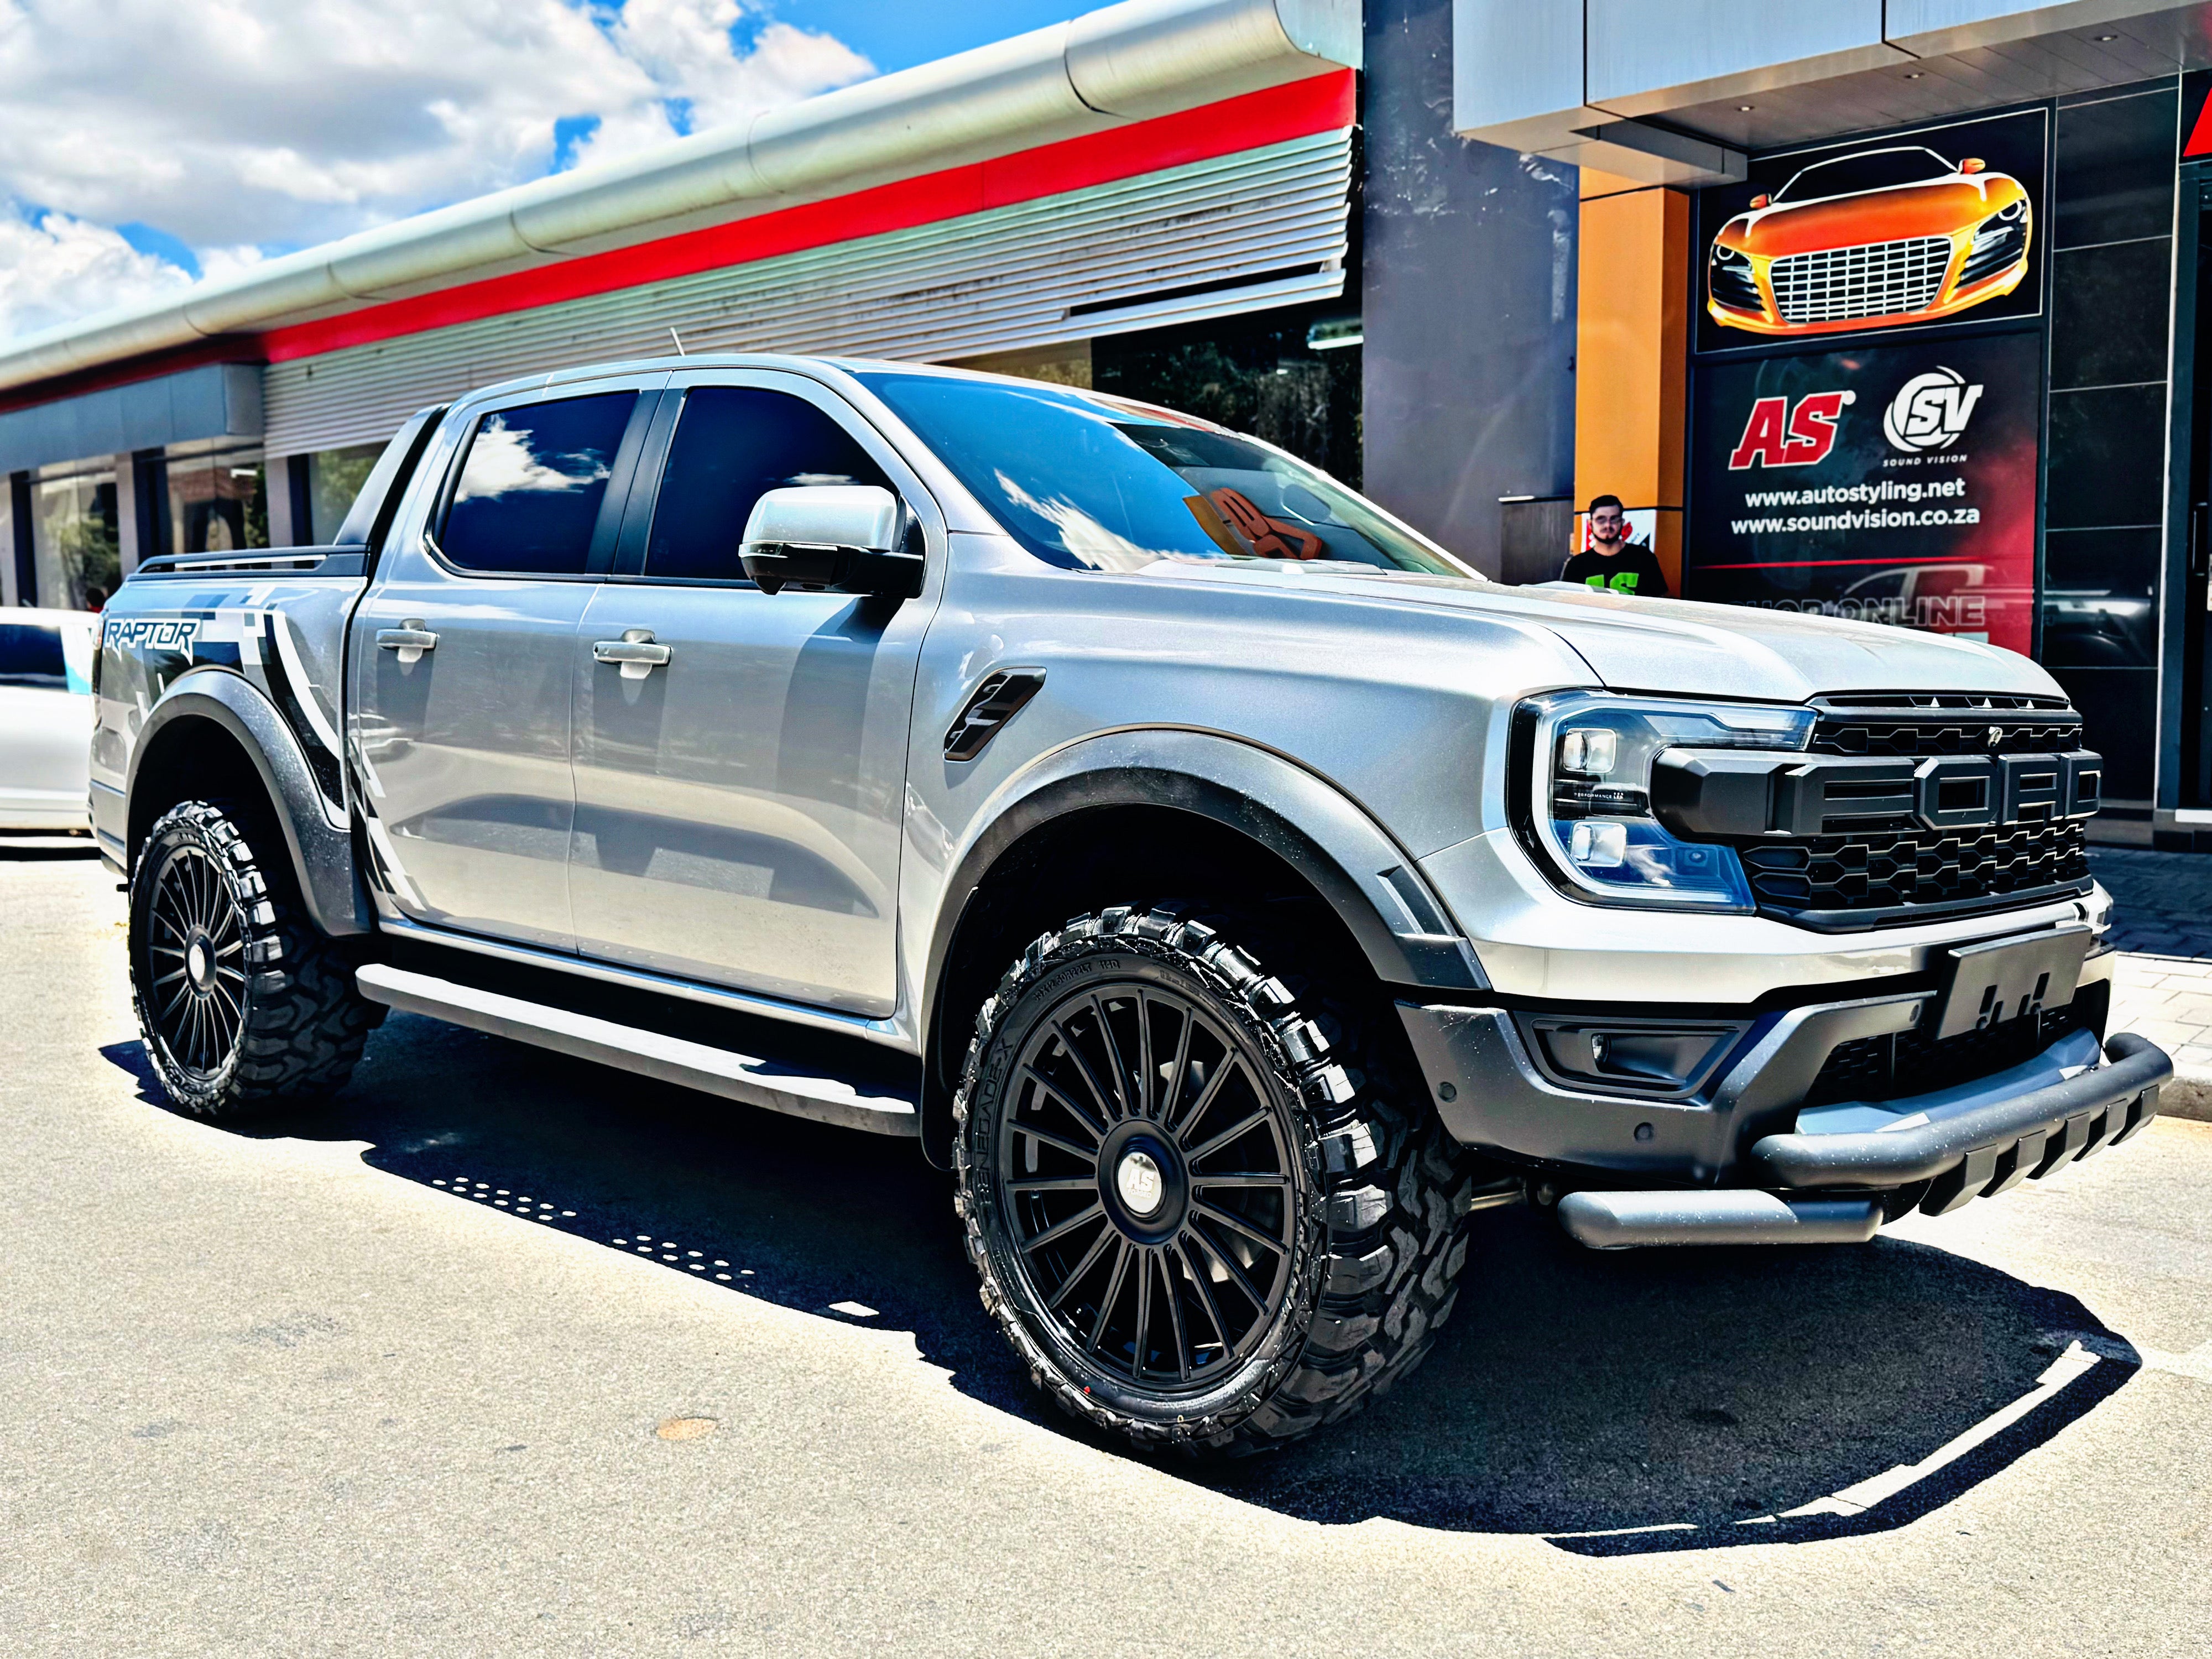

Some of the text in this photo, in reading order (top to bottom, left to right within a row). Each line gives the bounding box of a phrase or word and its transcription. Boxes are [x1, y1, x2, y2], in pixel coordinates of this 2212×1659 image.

[1728, 390, 1845, 470] AS
[1882, 454, 1968, 467] SOUND VISION
[1745, 478, 1965, 507] www.autostyling.net
[1731, 508, 1980, 534] www.soundvision.co.za
[1833, 596, 1985, 627] ONLINE
[106, 618, 200, 666] RAPTOR
[1767, 751, 2101, 836] FORD
